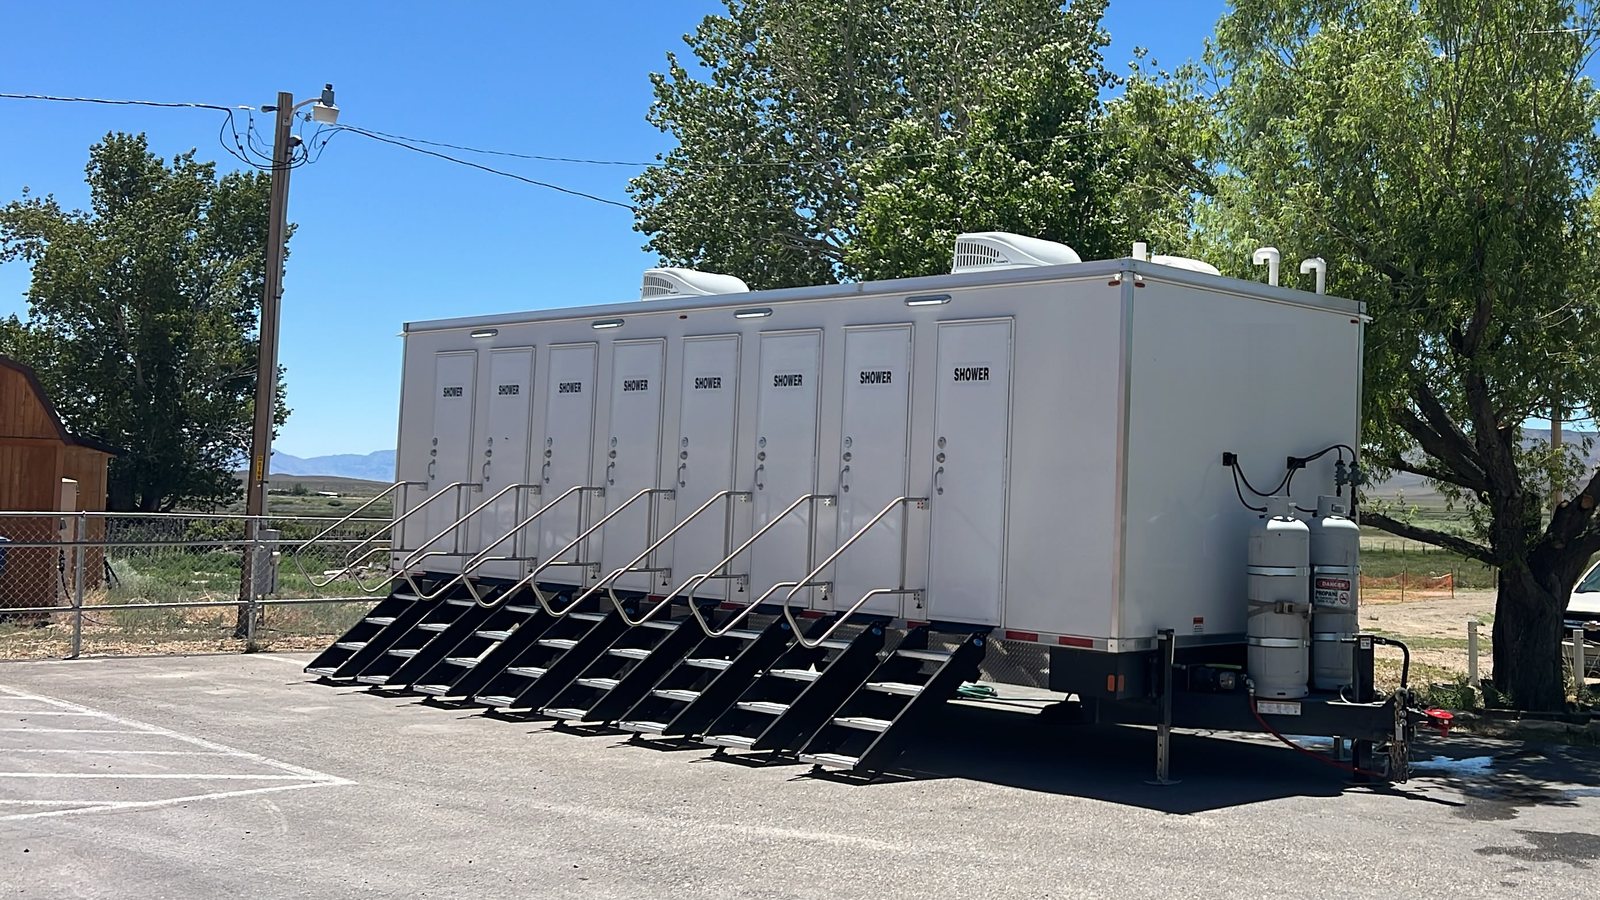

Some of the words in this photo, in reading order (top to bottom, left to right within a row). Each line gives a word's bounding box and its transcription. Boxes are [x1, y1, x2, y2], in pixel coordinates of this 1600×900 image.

[860, 371, 892, 384] SHOWER
[953, 367, 989, 381] SHOWER
[624, 380, 648, 391] SHOWER
[695, 377, 721, 389] SHOWER
[774, 375, 802, 387] SHOWER
[443, 387, 463, 397] SHOWER
[499, 385, 520, 395] SHOWER
[559, 383, 581, 393] SHOWER
